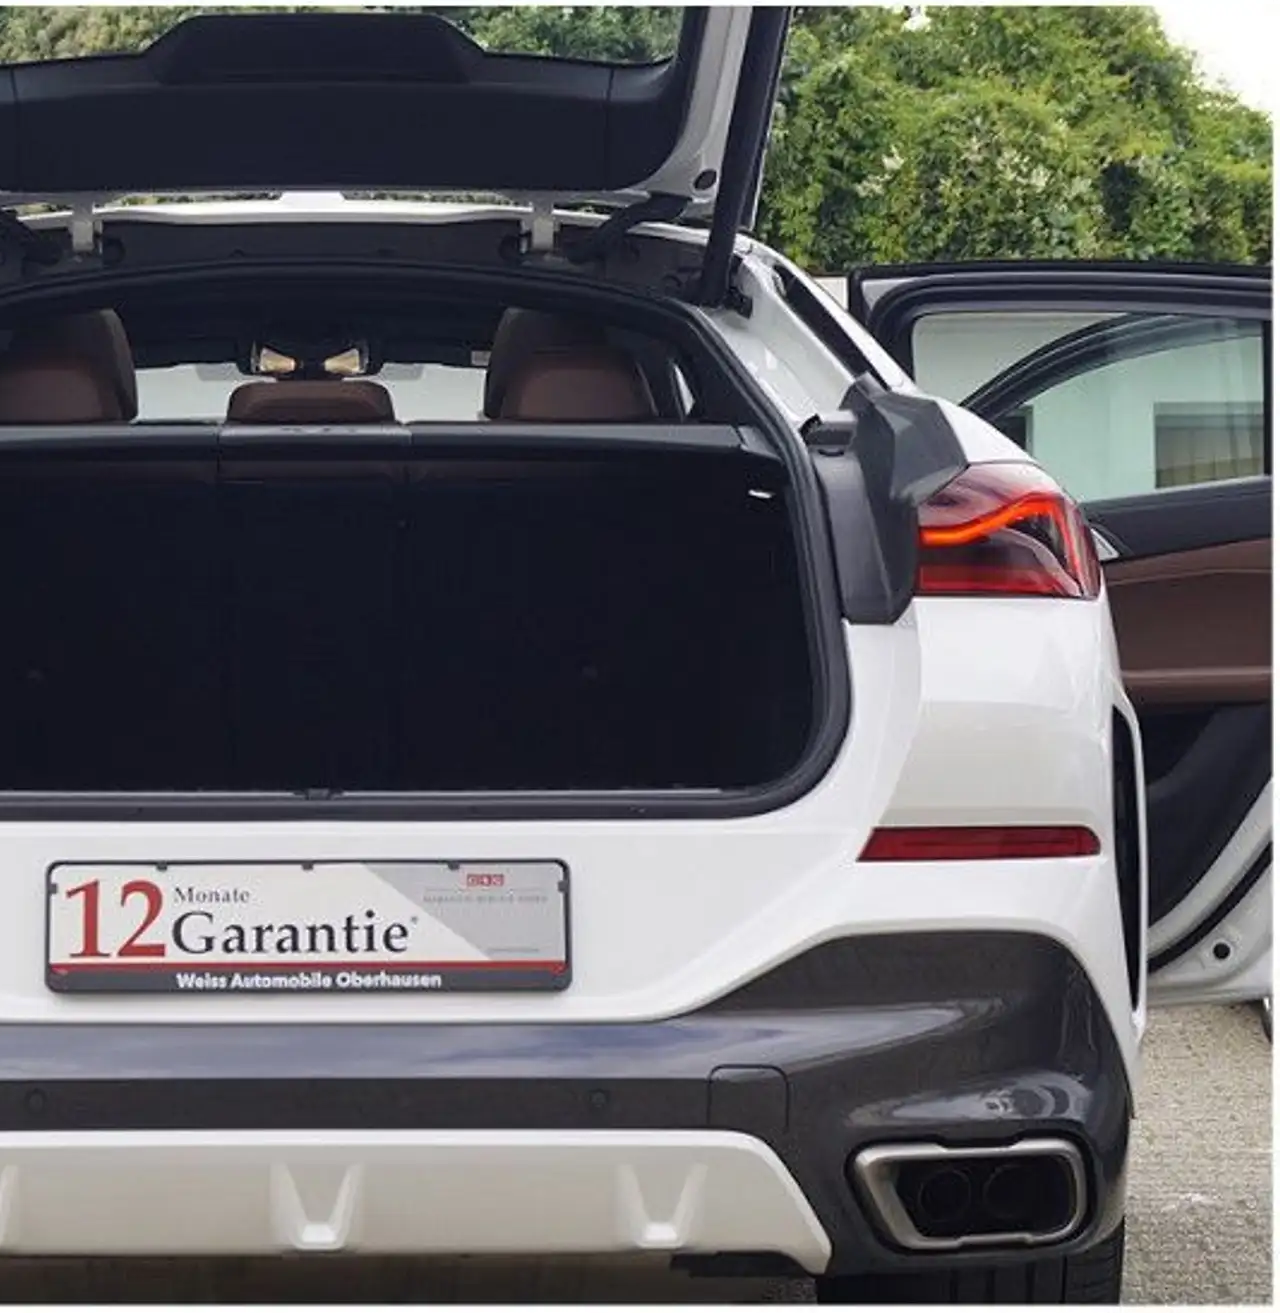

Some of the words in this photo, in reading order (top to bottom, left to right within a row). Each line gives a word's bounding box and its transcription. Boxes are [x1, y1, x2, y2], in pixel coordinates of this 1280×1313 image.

[174, 886, 251, 903] Monate
[66, 879, 166, 959] 12
[175, 973, 228, 988] Weiss
[231, 972, 332, 988] Automobile
[335, 971, 442, 987] Oberhausen
